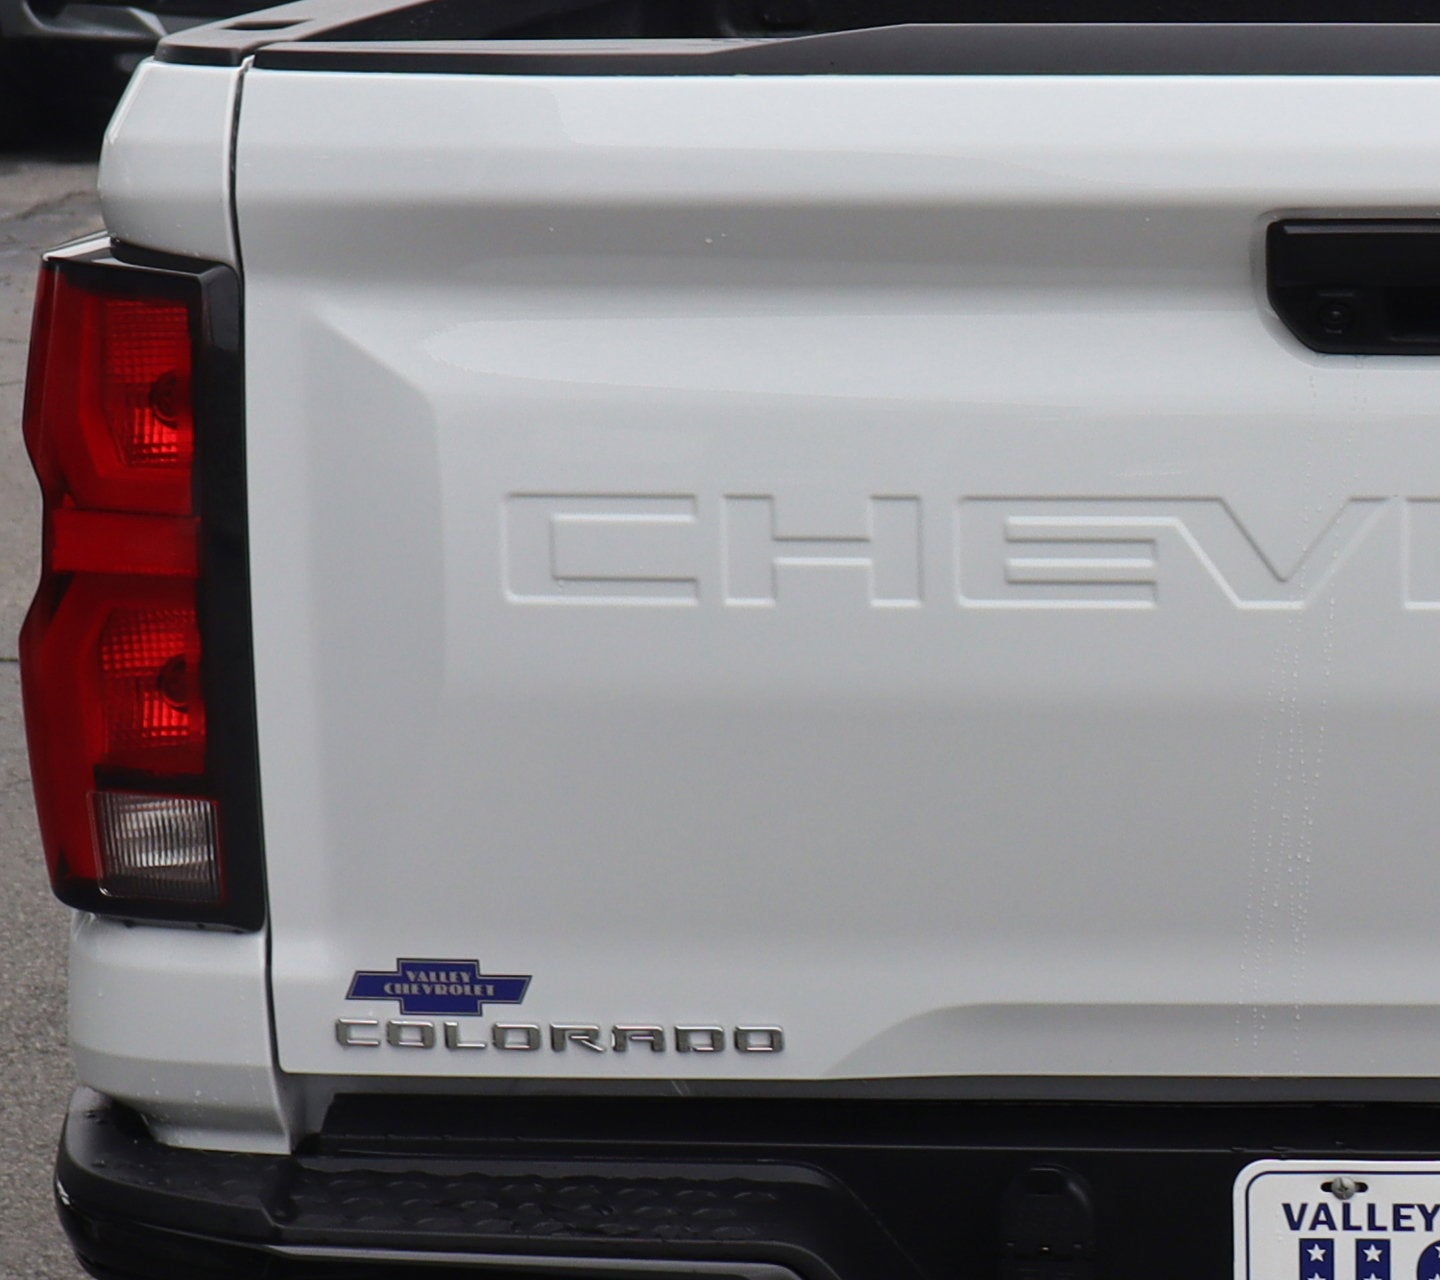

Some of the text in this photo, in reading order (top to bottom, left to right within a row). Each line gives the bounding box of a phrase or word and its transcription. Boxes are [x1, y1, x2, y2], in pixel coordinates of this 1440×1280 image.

[405, 970, 472, 984] VALLEY
[383, 982, 495, 997] CHEVROLET
[334, 1017, 785, 1054] COLORADO
